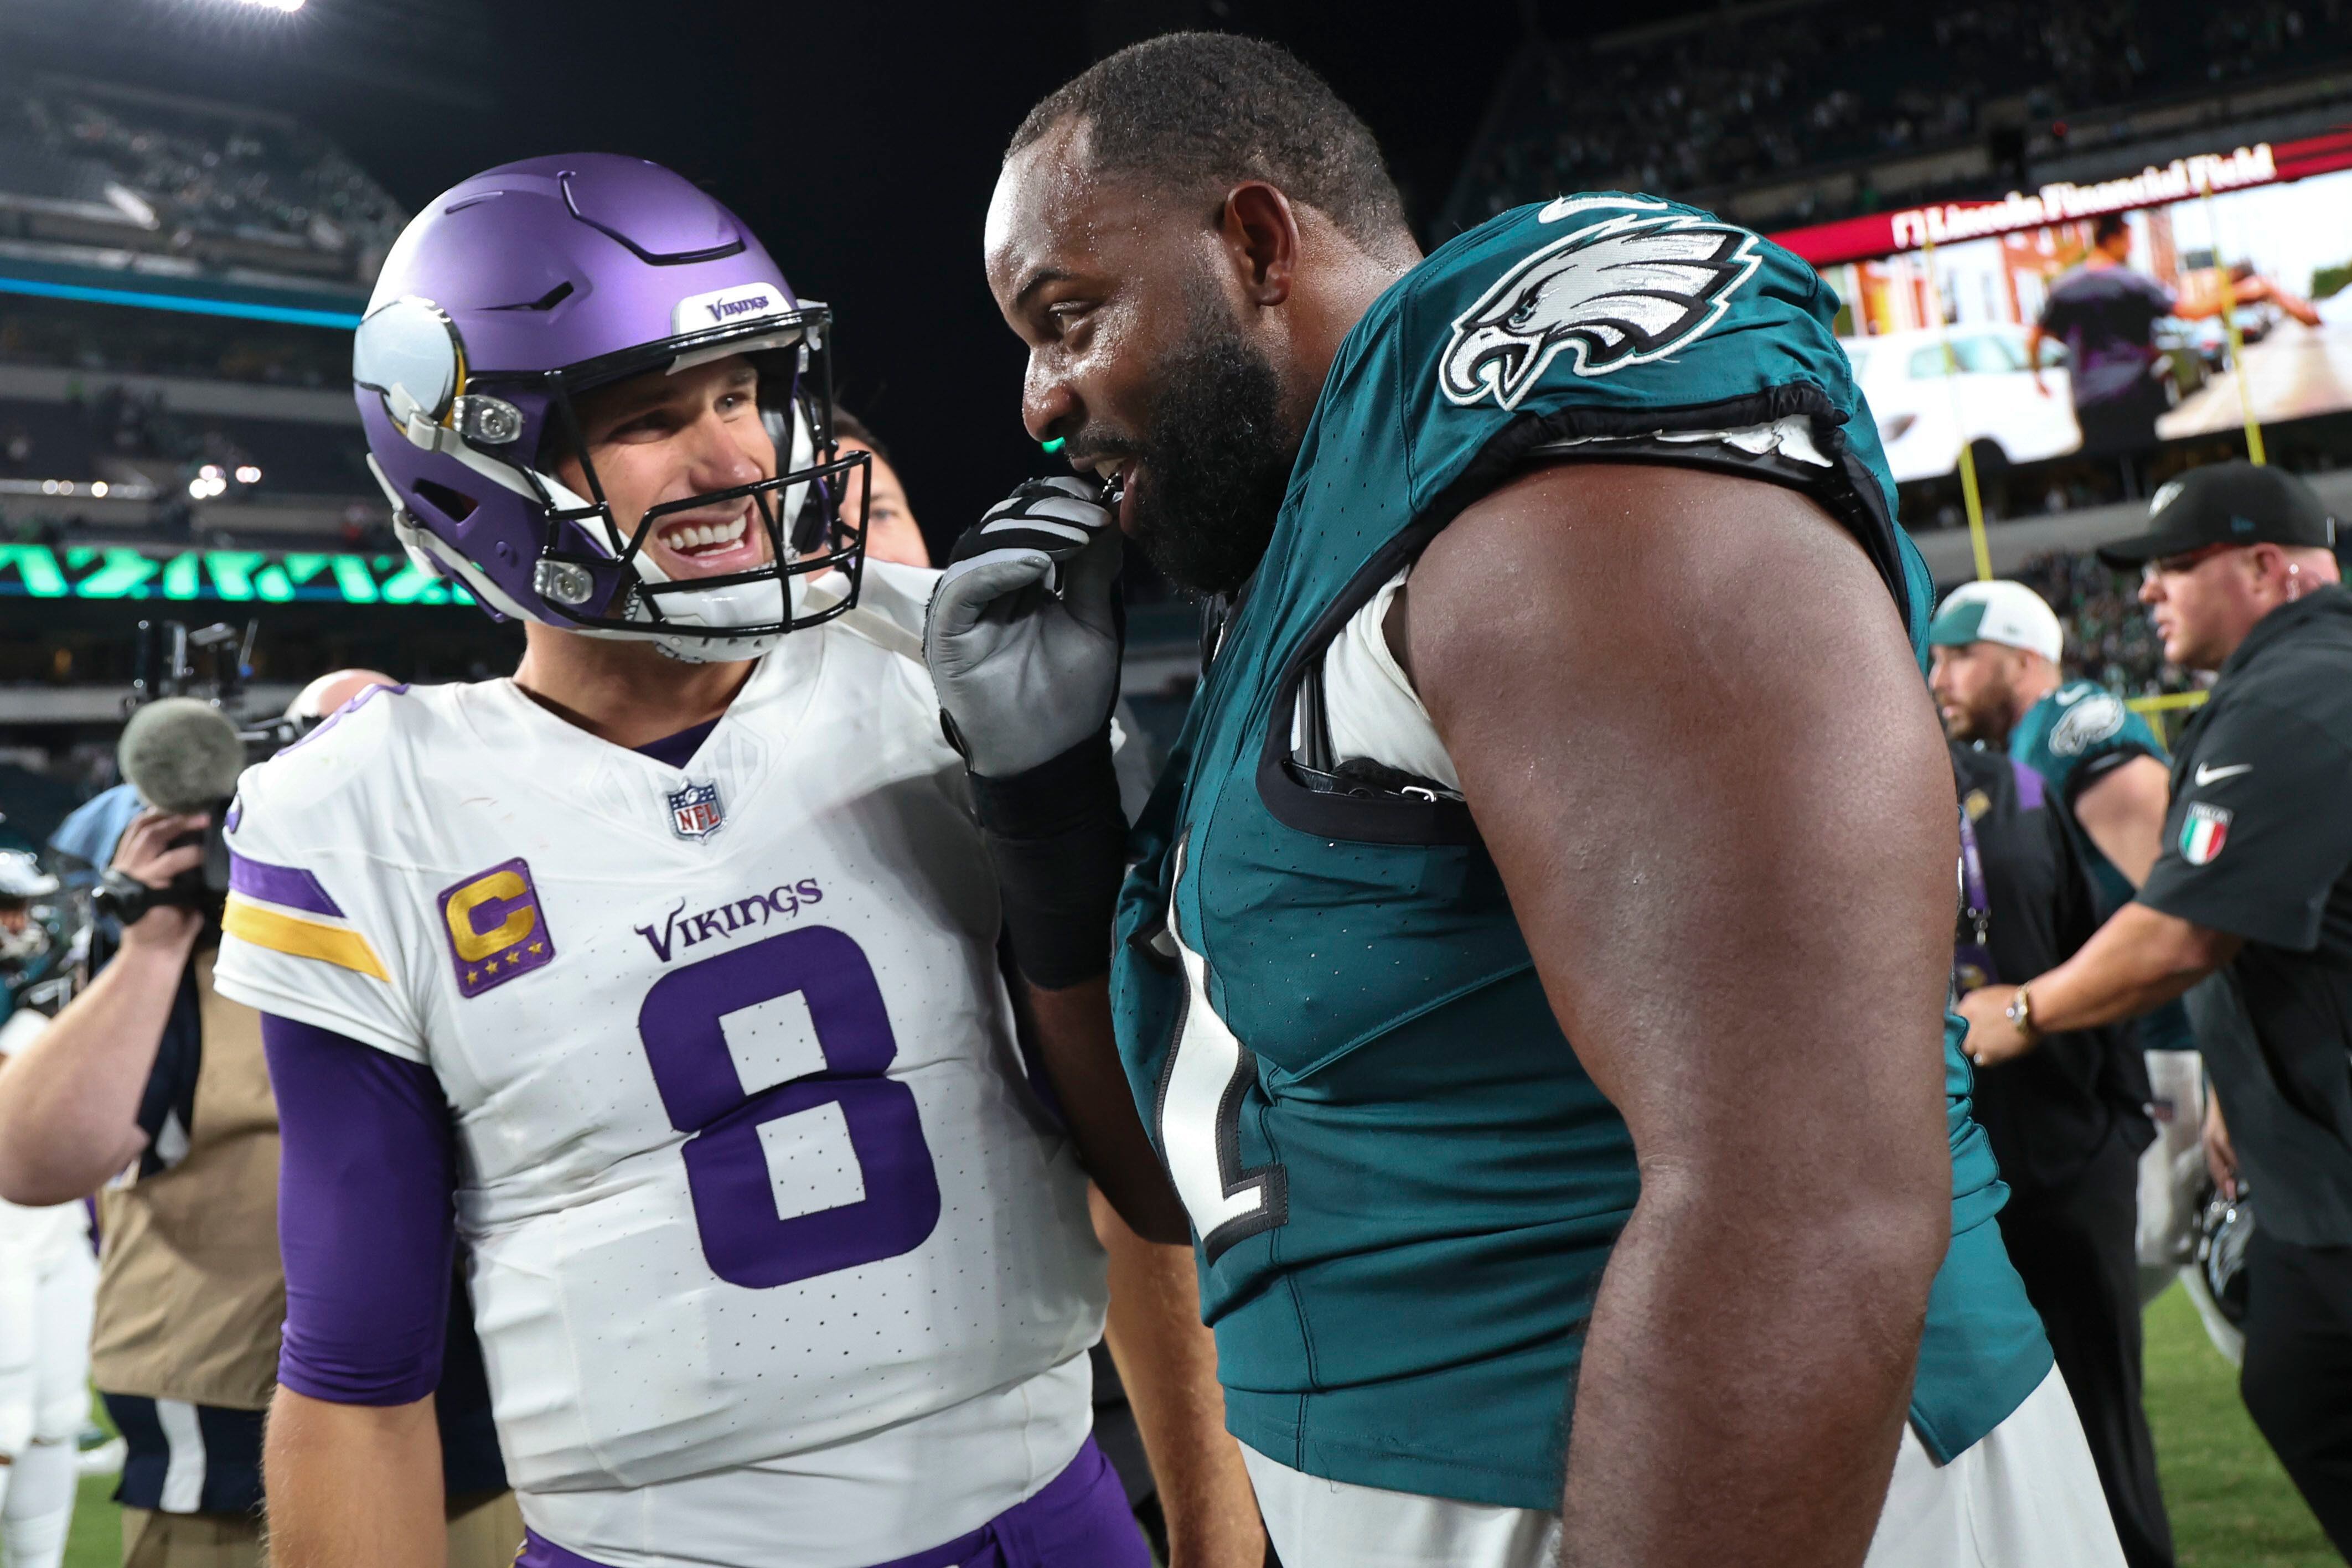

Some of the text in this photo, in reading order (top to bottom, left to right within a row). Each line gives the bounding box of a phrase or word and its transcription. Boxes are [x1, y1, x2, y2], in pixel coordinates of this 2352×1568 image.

[1926, 142, 2277, 239] Lincoln Financial Field
[677, 803, 719, 831] NFL
[446, 870, 536, 962] C
[638, 924, 942, 1289] 8
